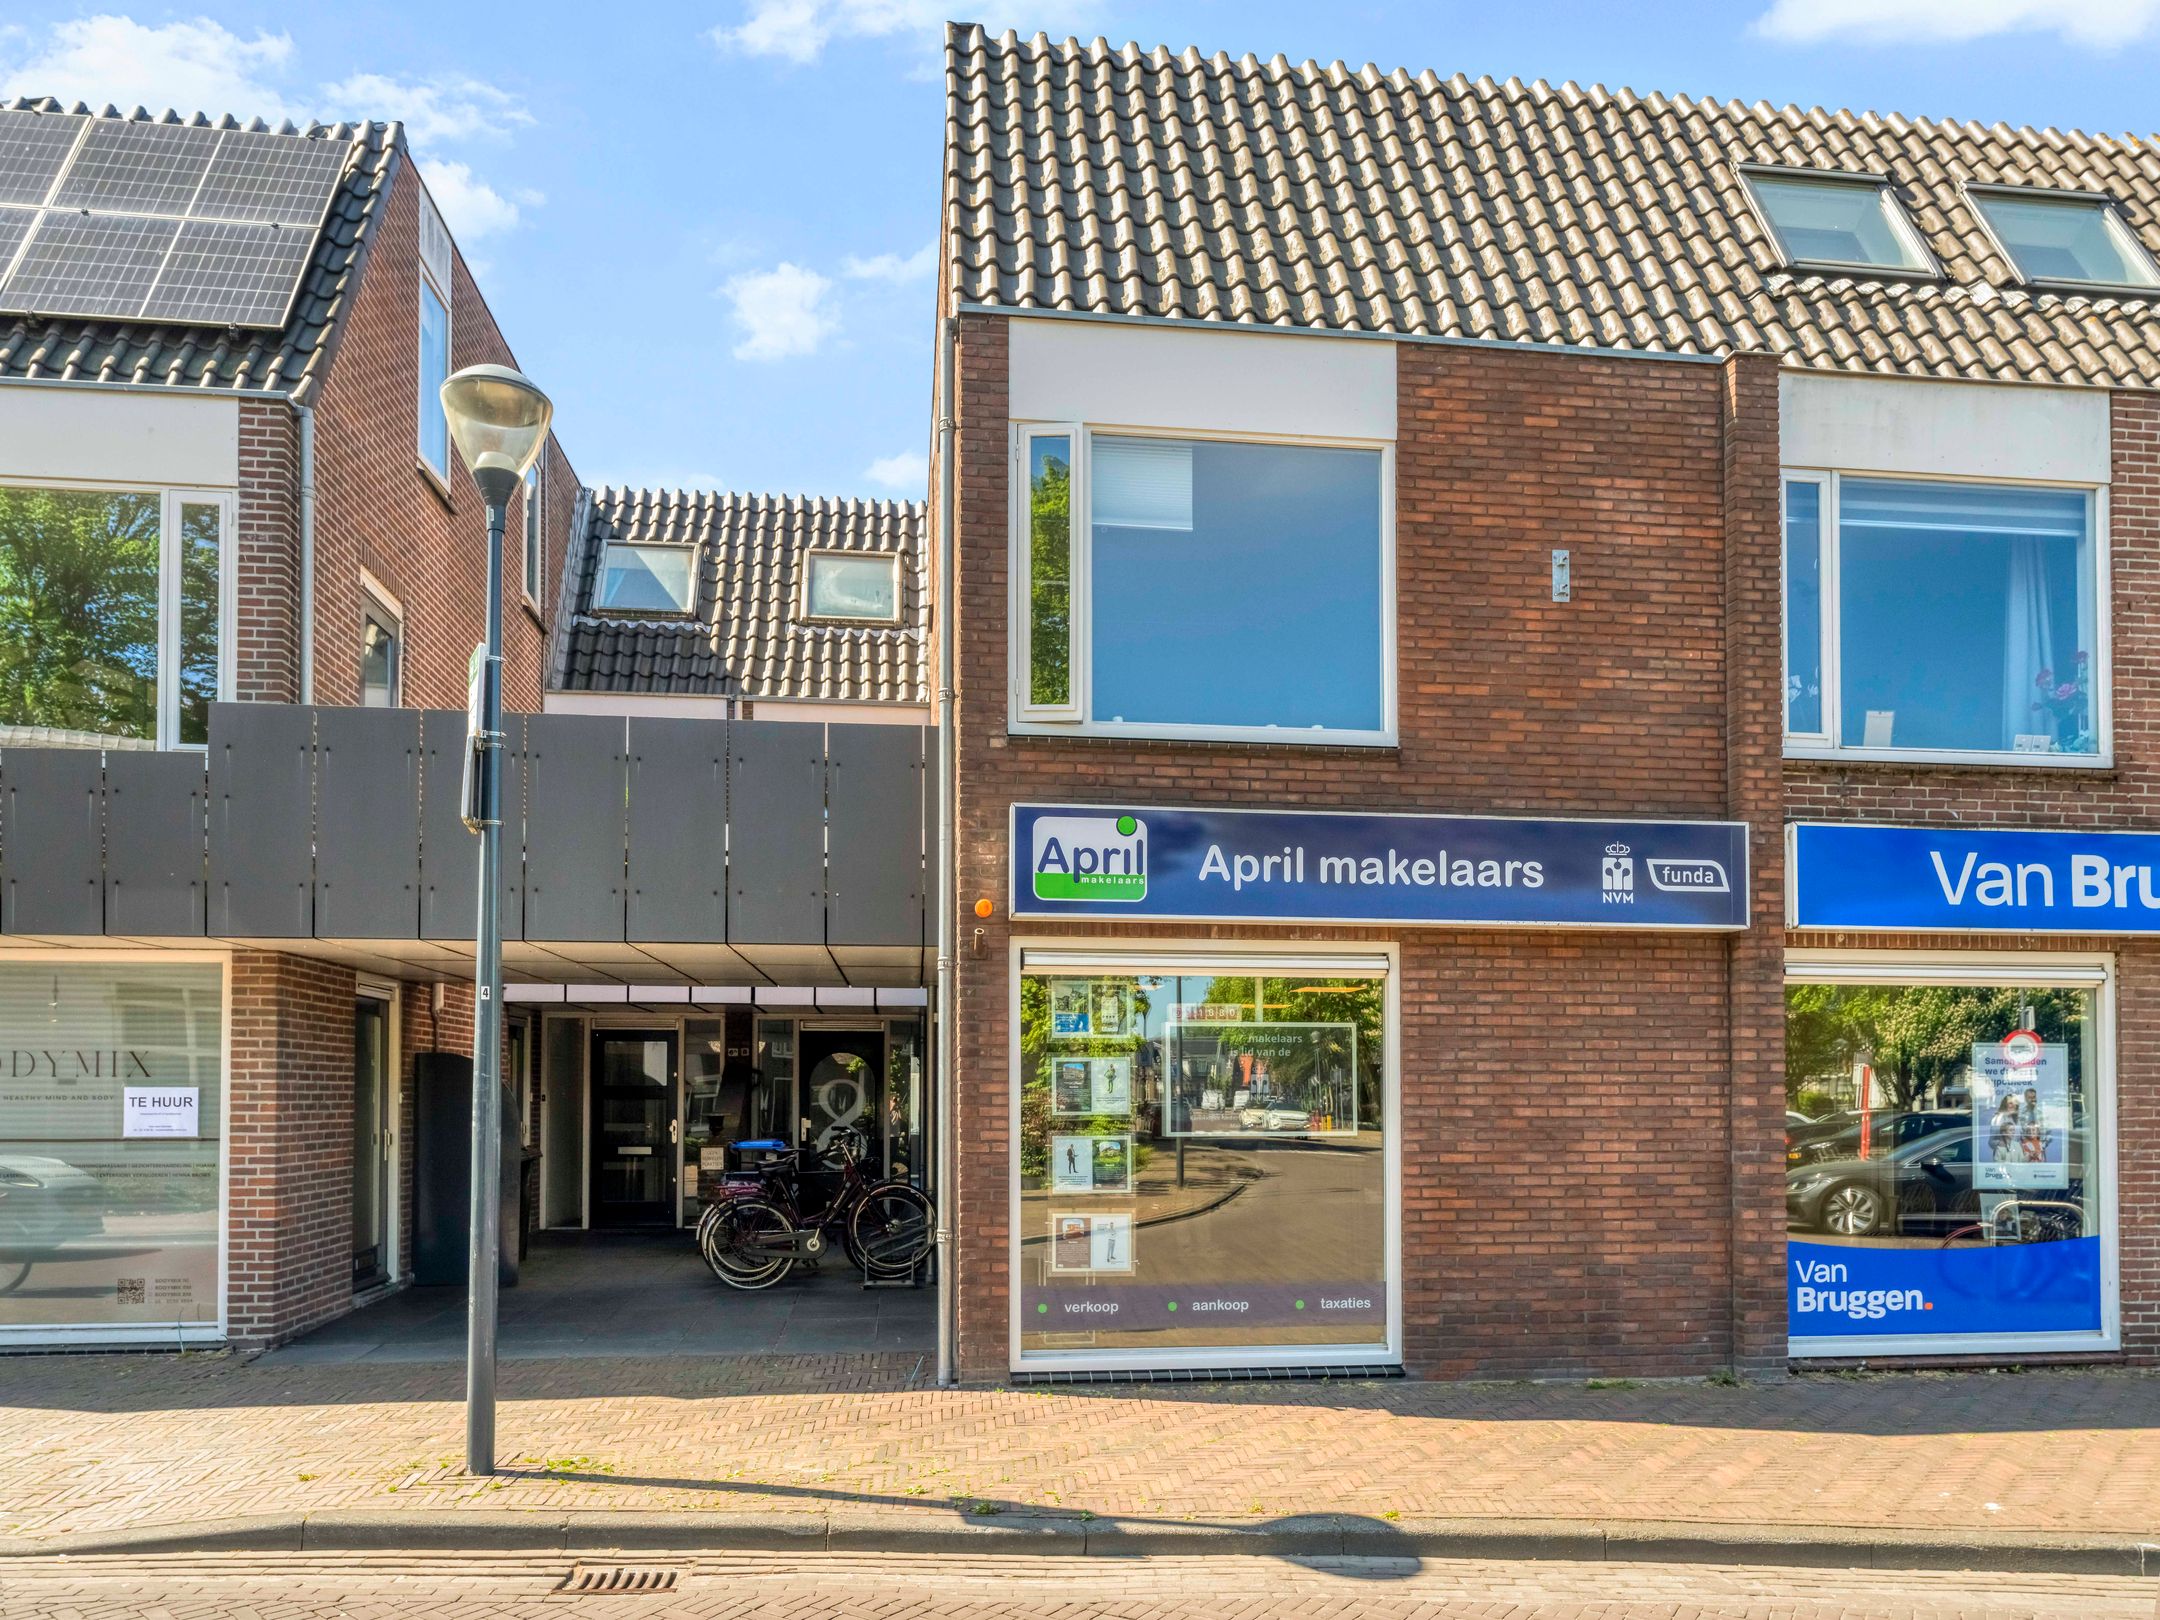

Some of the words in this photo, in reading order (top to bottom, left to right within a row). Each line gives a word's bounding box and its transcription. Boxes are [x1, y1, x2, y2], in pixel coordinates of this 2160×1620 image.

[1037, 837, 1144, 883] April
[1199, 844, 1305, 891] April
[1319, 848, 1545, 888] makelaars
[1081, 875, 1145, 886] makelaars
[1662, 866, 1714, 884] funda
[1929, 850, 2055, 907] Van
[1602, 891, 1634, 905] NVM
[482, 987, 489, 998] 4
[1241, 1047, 1254, 1057] lid
[1257, 1049, 1275, 1057] van
[1279, 1047, 1291, 1057] de
[0, 1050, 152, 1078] DYMIX
[129, 1096, 147, 1108] TE
[152, 1096, 193, 1108] HUUR
[1795, 1260, 1848, 1283] Van
[1064, 1300, 1119, 1316] verkoop
[1192, 1297, 1250, 1313] aankoop
[1320, 1295, 1372, 1311] taxaties
[1797, 1286, 1934, 1319] Bruggen.
